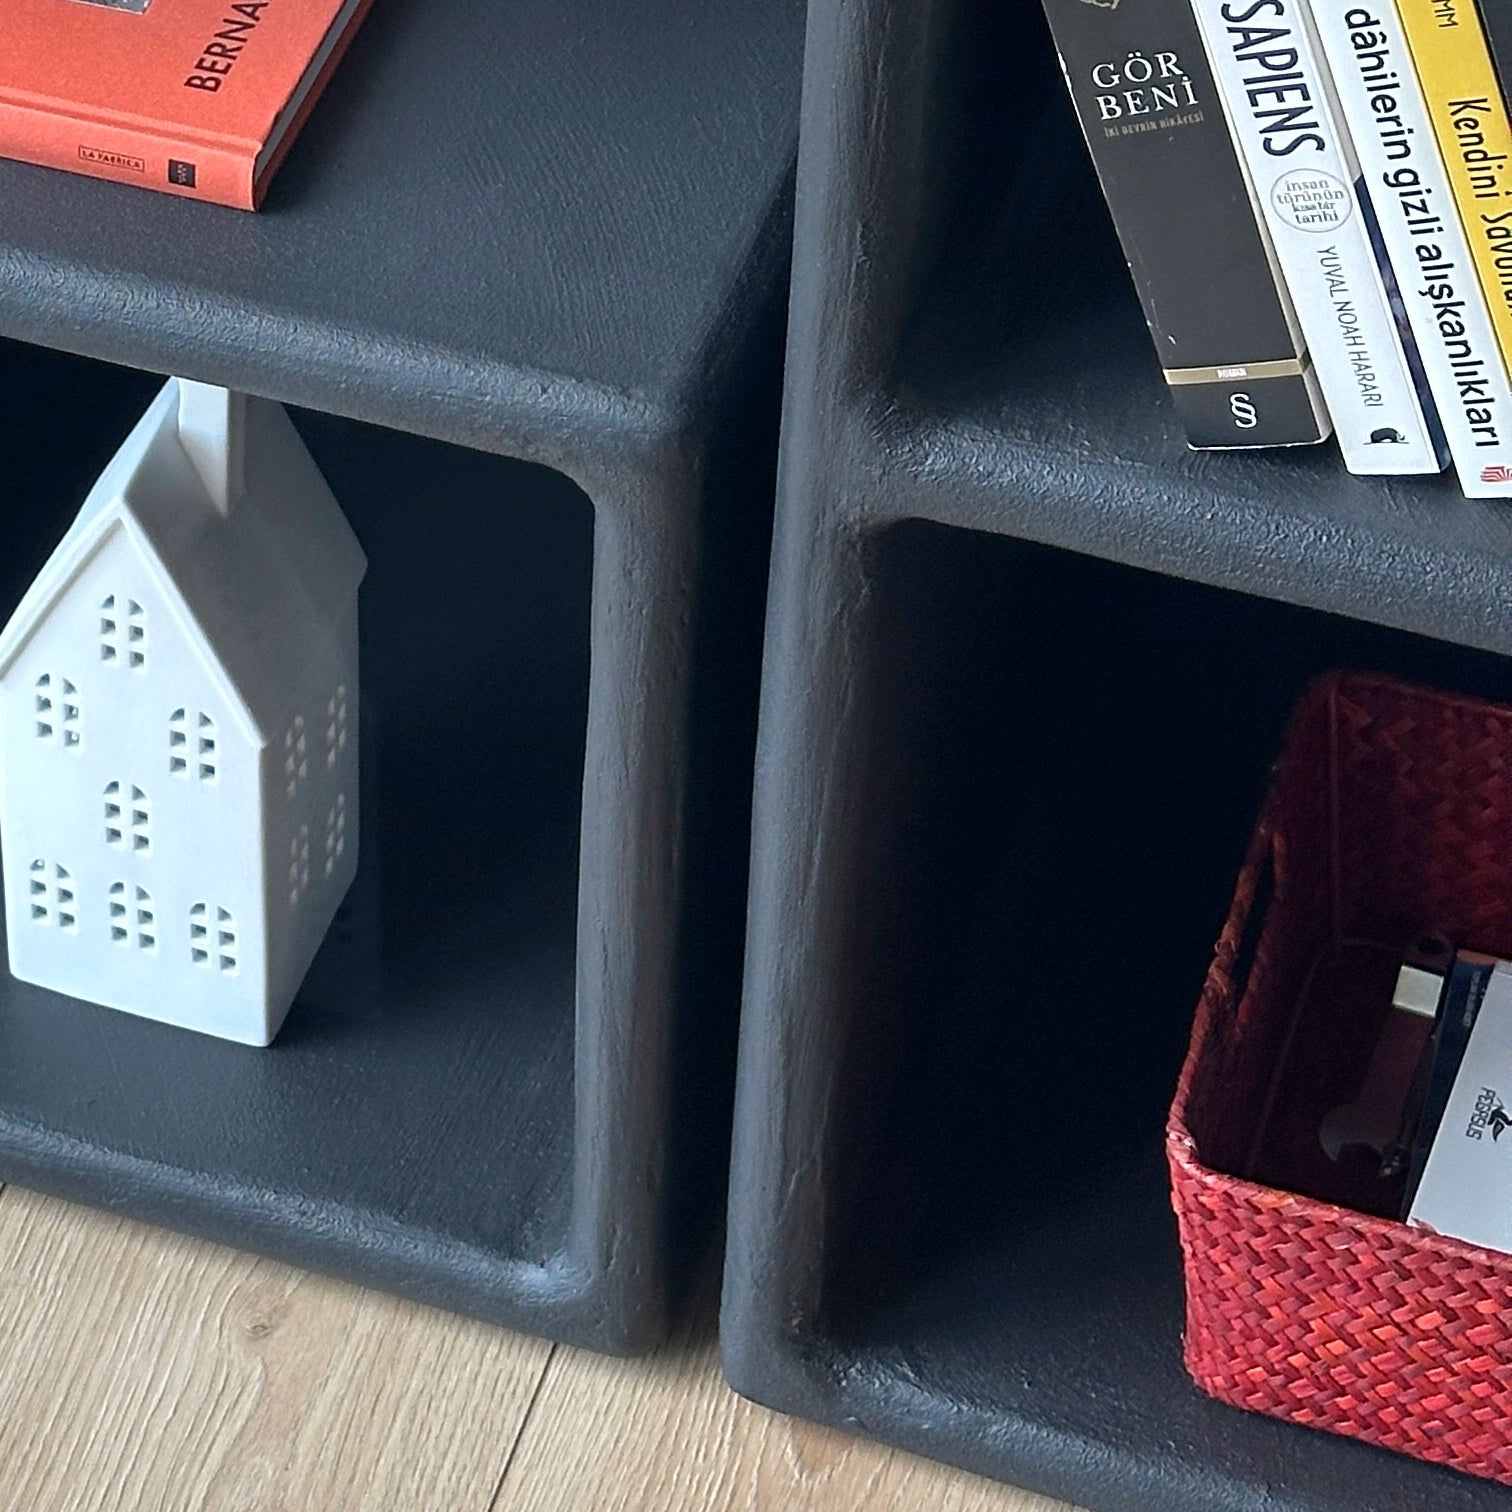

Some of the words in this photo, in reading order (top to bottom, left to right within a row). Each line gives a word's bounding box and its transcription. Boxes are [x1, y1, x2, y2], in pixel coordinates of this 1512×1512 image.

[1091, 51, 1185, 89] GÖR
[1095, 75, 1200, 121] BENİ
[1448, 97, 1511, 199] Kendini
[1295, 209, 1339, 224] tarihi
[1344, 8, 1414, 161] dâhilerin
[1383, 167, 1444, 235] gizli
[1415, 243, 1500, 448] alışkanlıkları
[1317, 245, 1349, 297] YUVAL
[1333, 300, 1366, 347] NOAH
[1348, 350, 1384, 407] HARARI
[1466, 1086, 1496, 1140] PEGASUS
